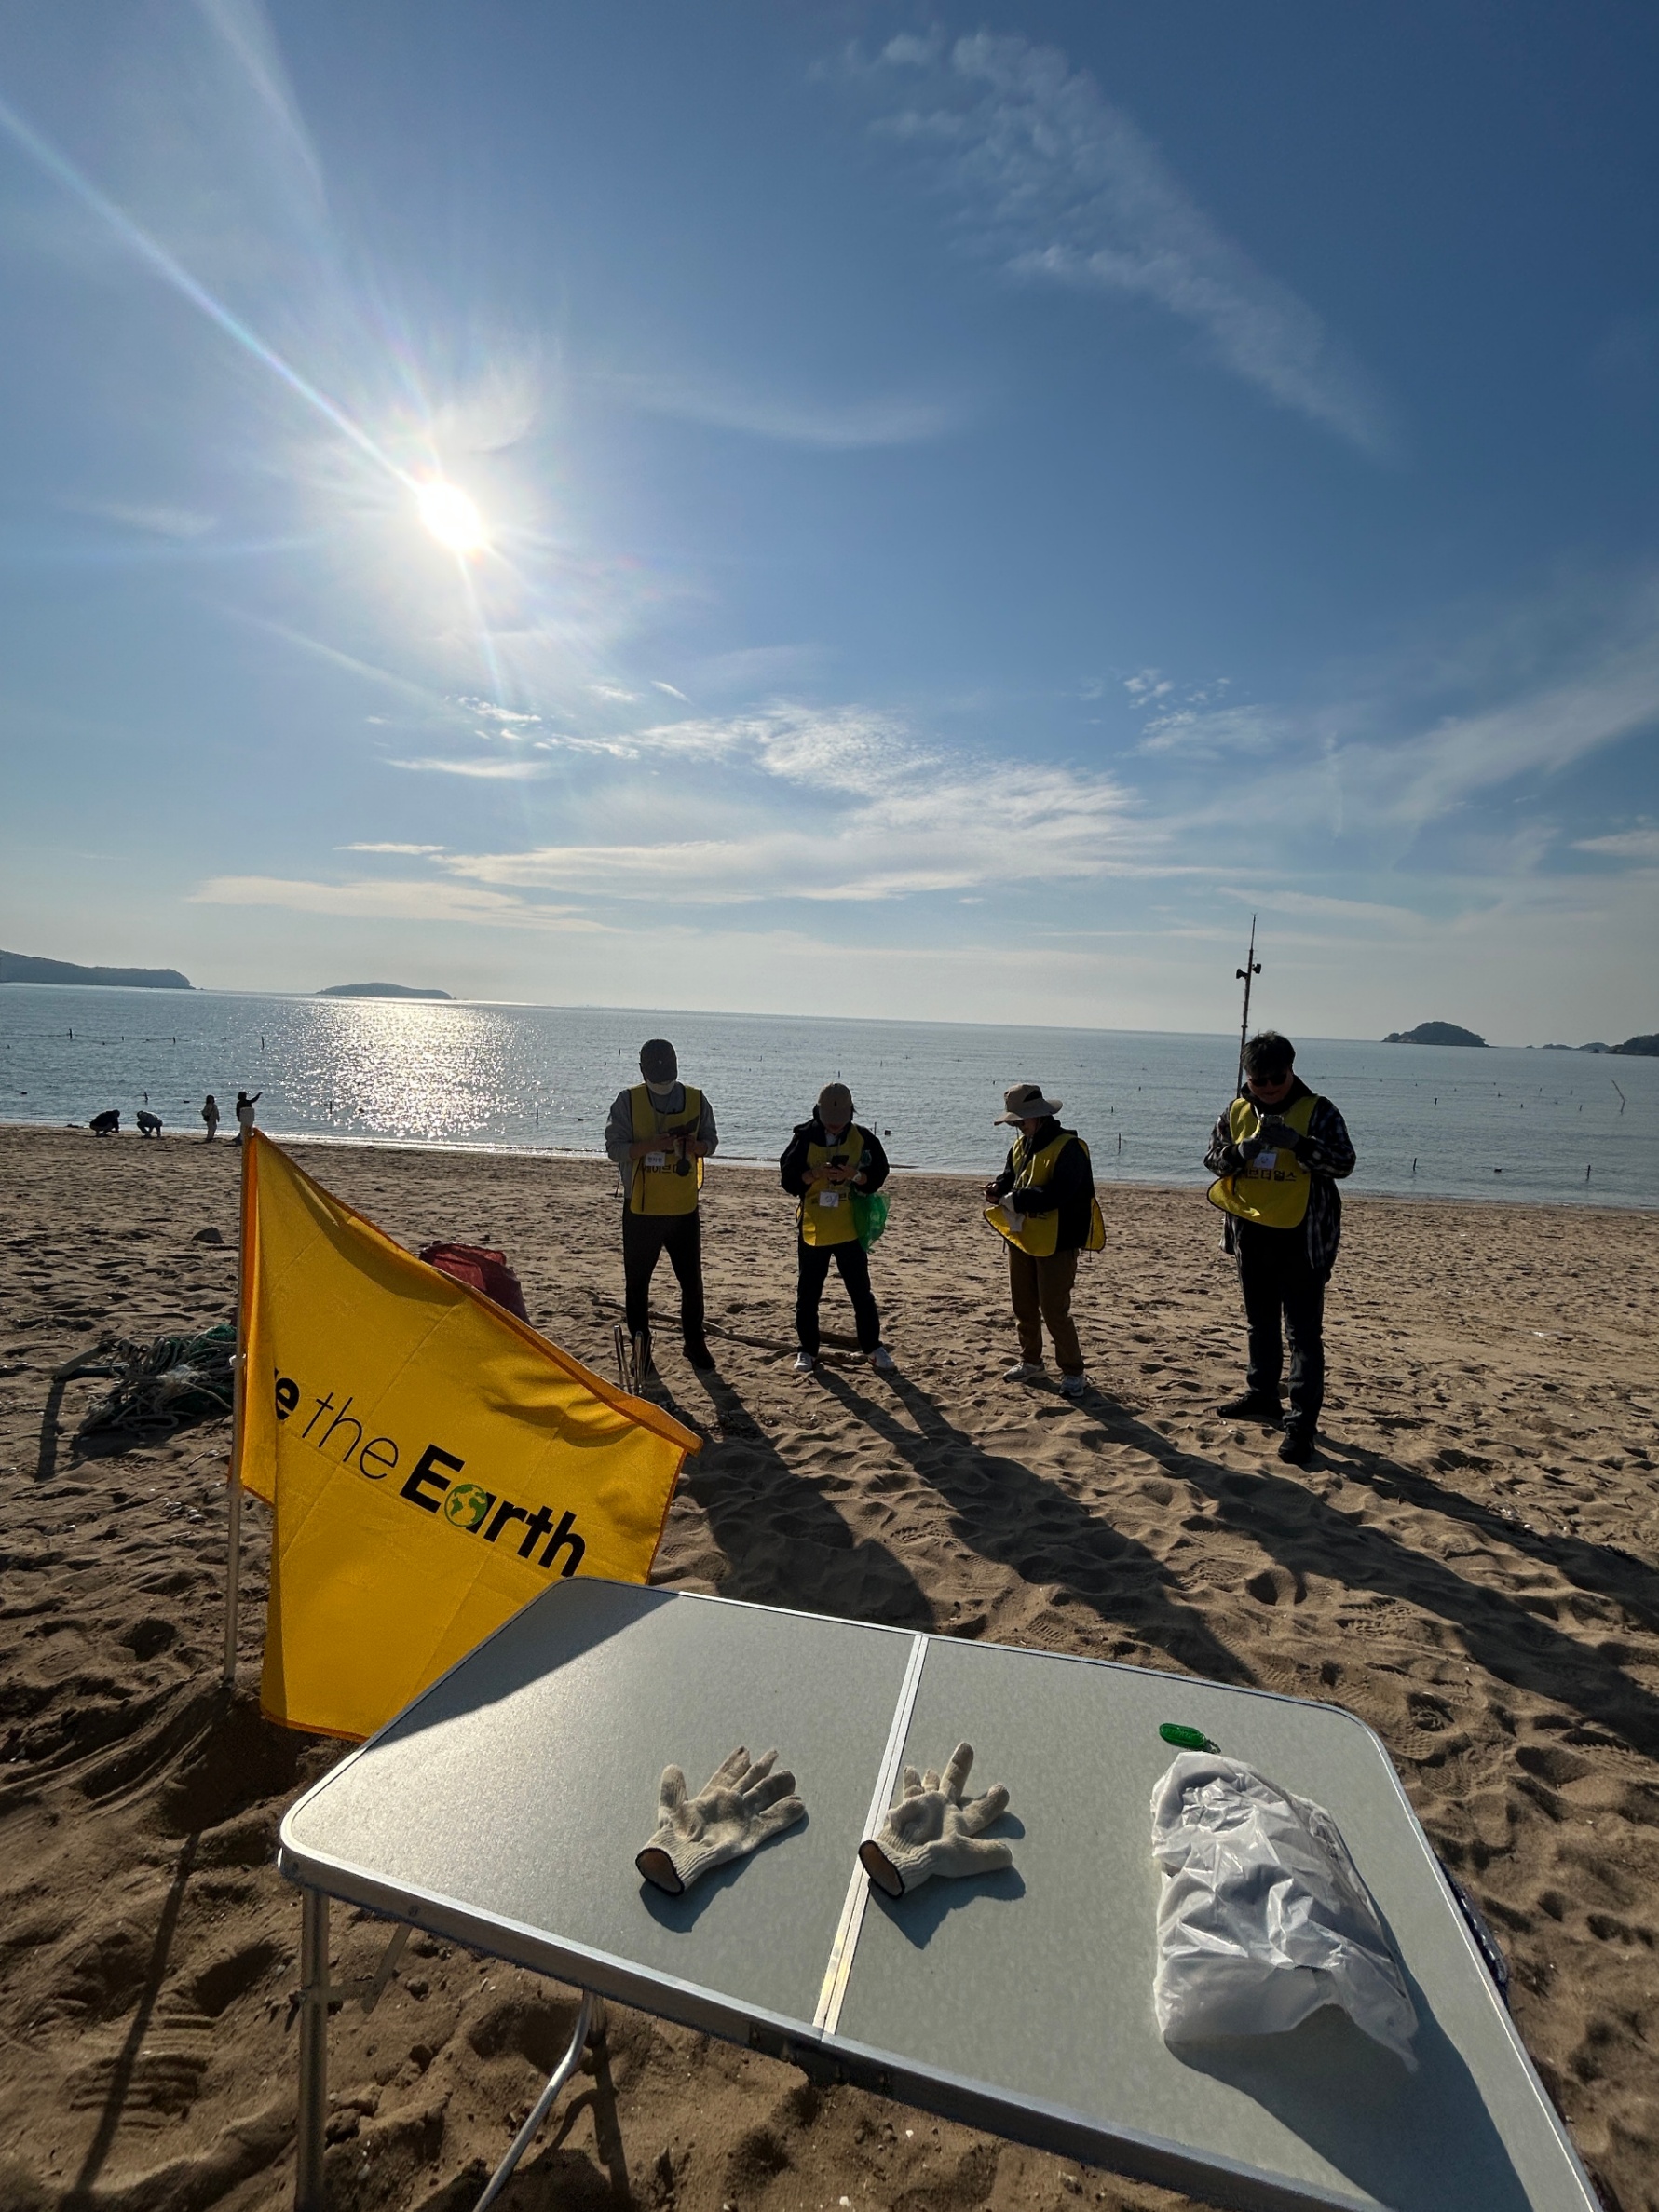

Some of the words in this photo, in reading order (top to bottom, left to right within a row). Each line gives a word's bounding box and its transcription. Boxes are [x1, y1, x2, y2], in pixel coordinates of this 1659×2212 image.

[1245, 1168, 1298, 1182] 브더얼스
[274, 1366, 300, 1421] e
[302, 1391, 400, 1480] the
[399, 1443, 587, 1578] Earth
